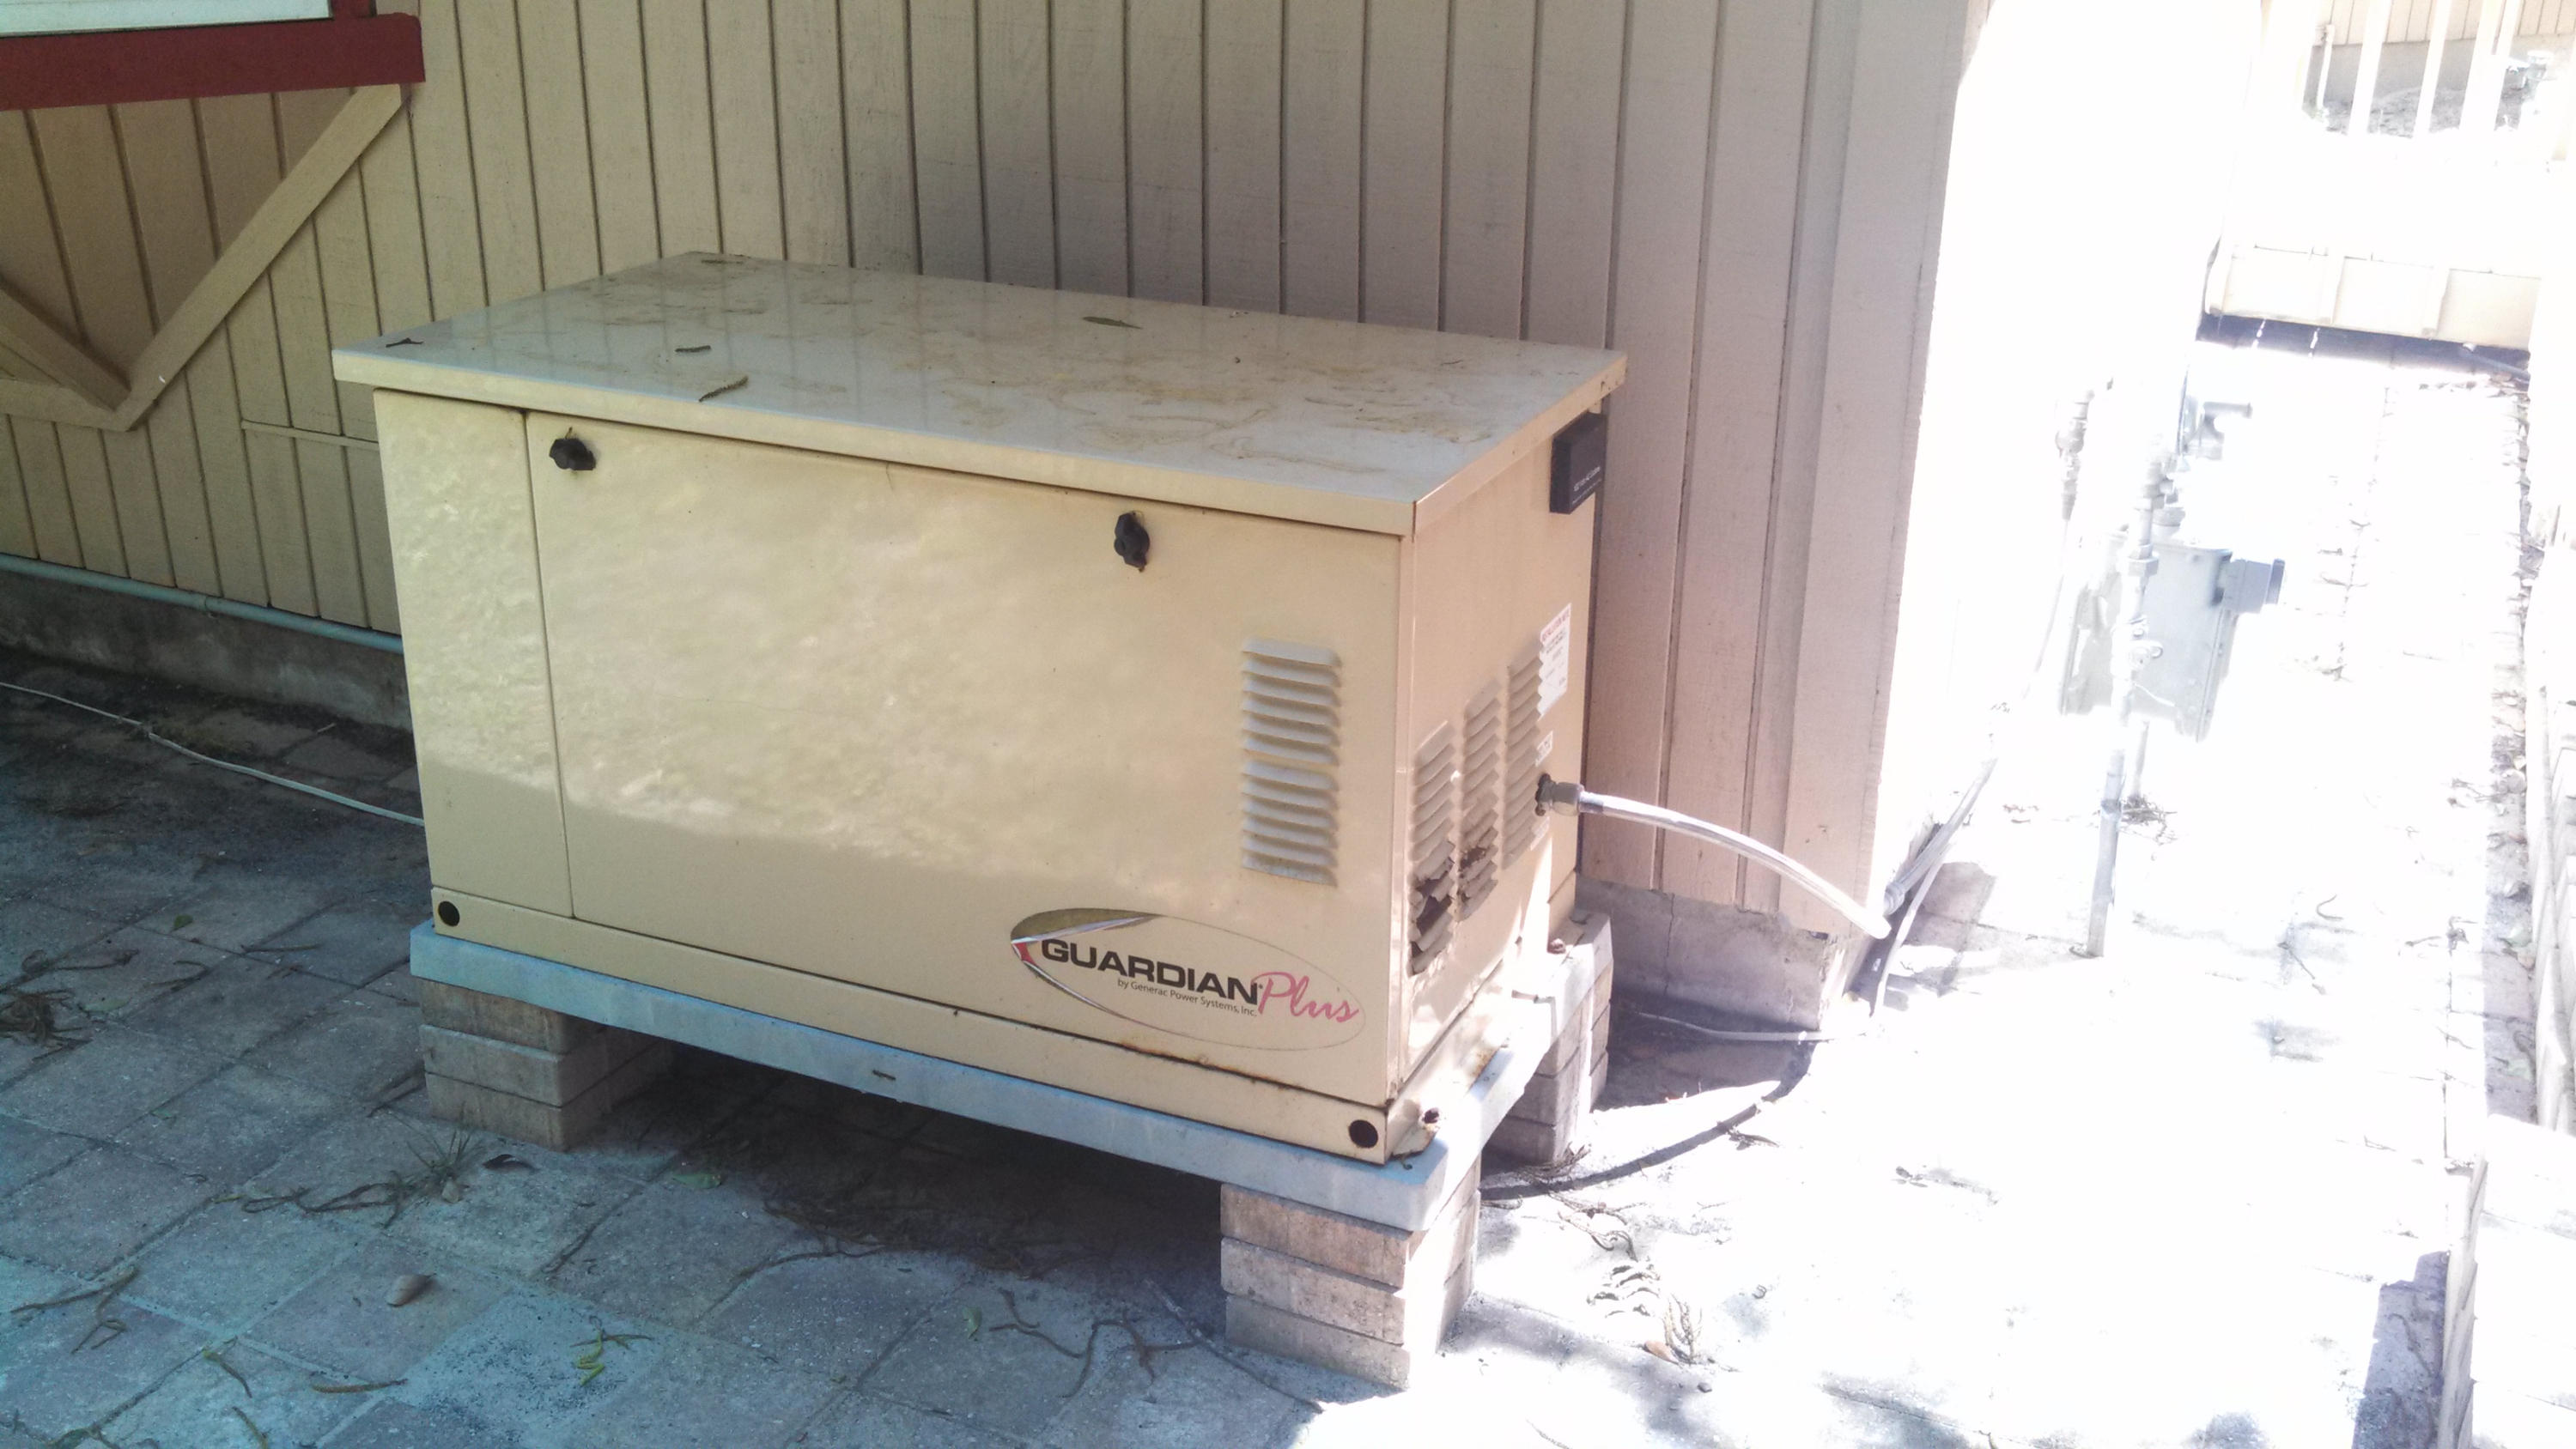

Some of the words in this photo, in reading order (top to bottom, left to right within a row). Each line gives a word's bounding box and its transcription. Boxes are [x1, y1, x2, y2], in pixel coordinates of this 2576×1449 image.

[1042, 938, 1257, 1005] GUARDIAN
[1251, 972, 1359, 1022] Plus
[1118, 979, 1128, 990] by
[1131, 981, 1168, 997] Generac
[1170, 991, 1198, 1003] Power
[1241, 1005, 1257, 1016] Inc.
